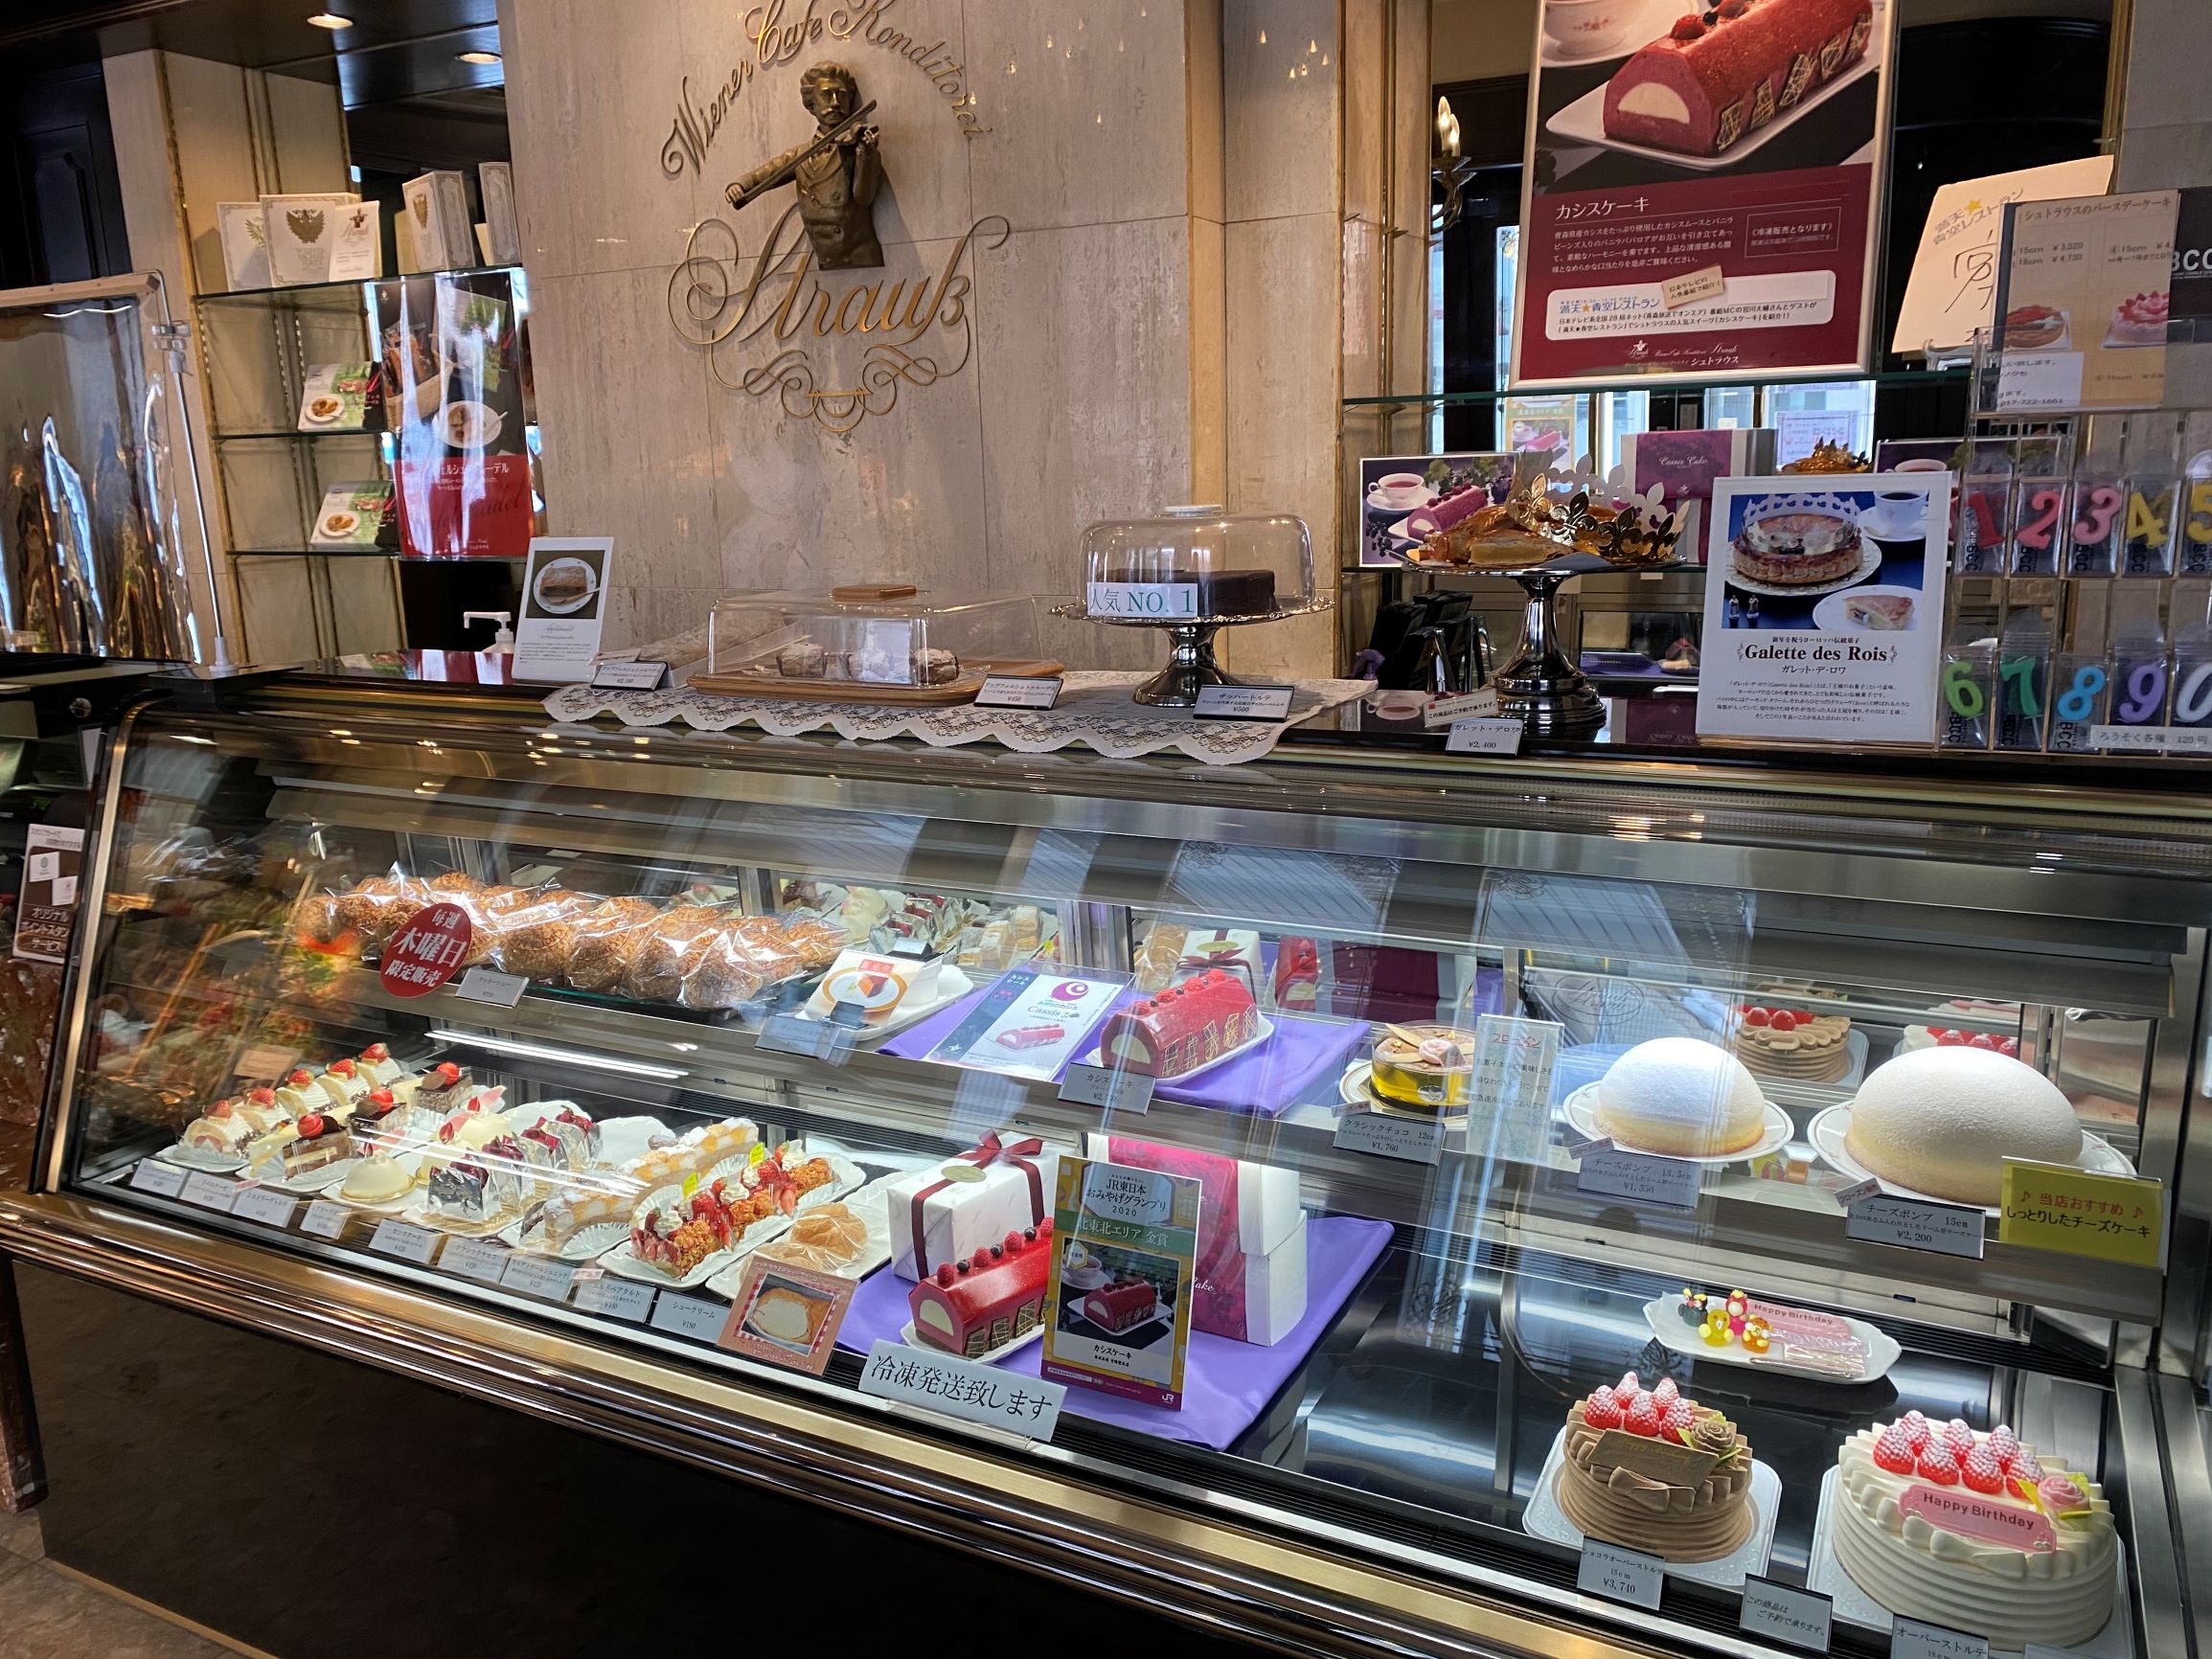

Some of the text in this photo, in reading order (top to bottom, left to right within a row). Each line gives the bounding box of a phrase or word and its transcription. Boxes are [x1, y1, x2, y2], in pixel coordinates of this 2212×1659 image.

[661, 57, 754, 176] Wiener
[829, 0, 992, 140] Konditorei
[1556, 196, 1650, 220] カシスケーキ
[1968, 490, 2005, 550] 1
[2016, 489, 2062, 550] 2
[2073, 486, 2123, 545] 3
[2126, 490, 2168, 550] 4
[1089, 588, 1121, 613] 人気
[1181, 589, 1195, 613] 1
[1745, 644, 1887, 662] Galette des Rois
[1944, 661, 1984, 717] 6
[1999, 655, 2040, 716] 7
[2057, 665, 2106, 721] 8
[2118, 663, 2167, 724] 9
[2057, 721, 2074, 749] BCC
[2099, 731, 2166, 743] ろうそく各種
[433, 909, 461, 931] 毎週
[394, 929, 469, 967] 木曜日
[385, 960, 443, 987] 限定販売
[1028, 1006, 1060, 1016] Cassis
[1344, 1119, 1409, 1136] クラシックチョコ
[1372, 1142, 1399, 1152] ¥1,760
[1106, 1179, 1147, 1194] JR東日本
[1624, 1182, 1654, 1193] ¥1,350
[1086, 1188, 1166, 1212] おみやげグランプリ
[1112, 1206, 1137, 1216] 2020
[2039, 1193, 2124, 1216] 当店おすすめ
[1078, 1217, 1169, 1247] 北東北エリア 金賞
[2006, 1205, 2152, 1239] しっとりしたチーズケーキ
[1897, 1230, 1932, 1243] ¥2,200
[673, 1301, 716, 1319] シュークリーム
[1754, 1304, 1833, 1326] Happy Birthday
[1093, 1345, 1132, 1359] カシスケーキ
[871, 1355, 1053, 1420] 冷凍発送致します
[1162, 1394, 1174, 1402] JR
[1924, 1492, 2035, 1531] Happy Birthday
[1604, 1578, 1635, 1595] ¥3,740
[1747, 1595, 1789, 1614] この商品は
[1757, 1609, 1825, 1636] ご予約で承ります。
[1897, 1626, 1987, 1656] オーバーストルテ
